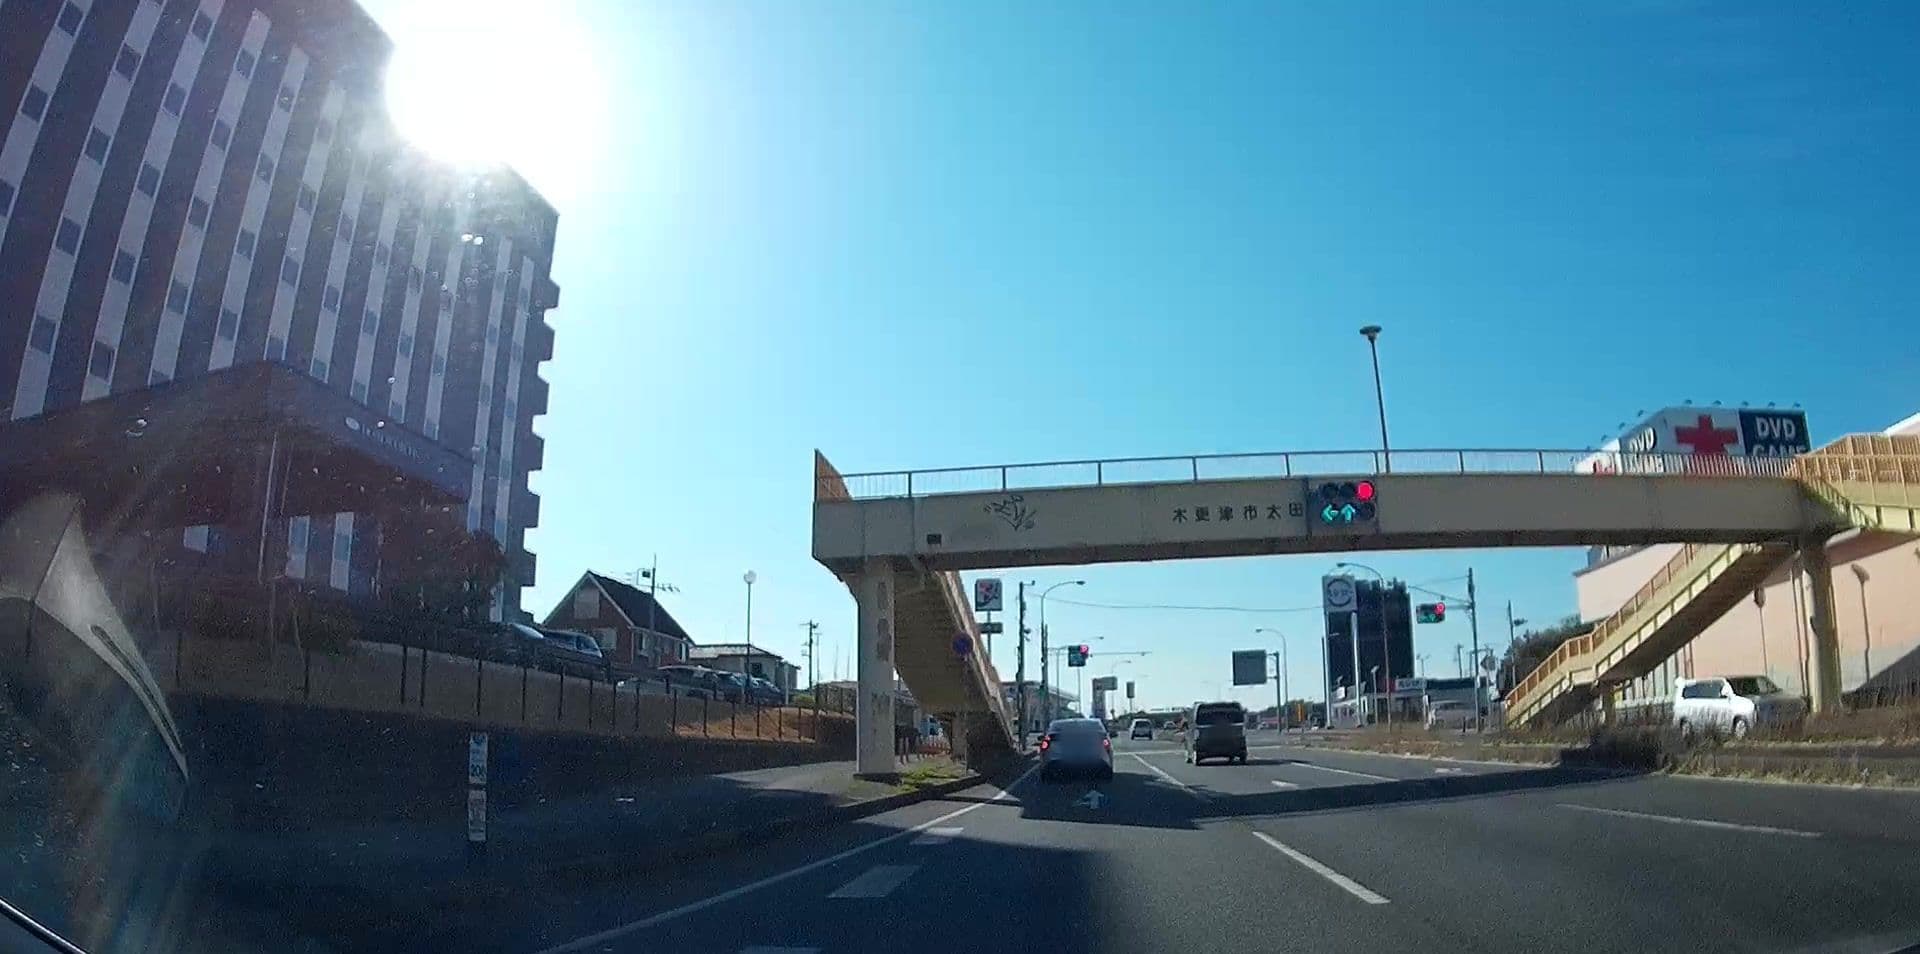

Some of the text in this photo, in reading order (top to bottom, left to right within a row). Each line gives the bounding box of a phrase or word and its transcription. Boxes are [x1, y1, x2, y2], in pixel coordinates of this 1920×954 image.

[1629, 427, 1656, 452] DVD
[1755, 416, 1796, 440] DVD
[1172, 502, 1304, 523] 木更津市太田
